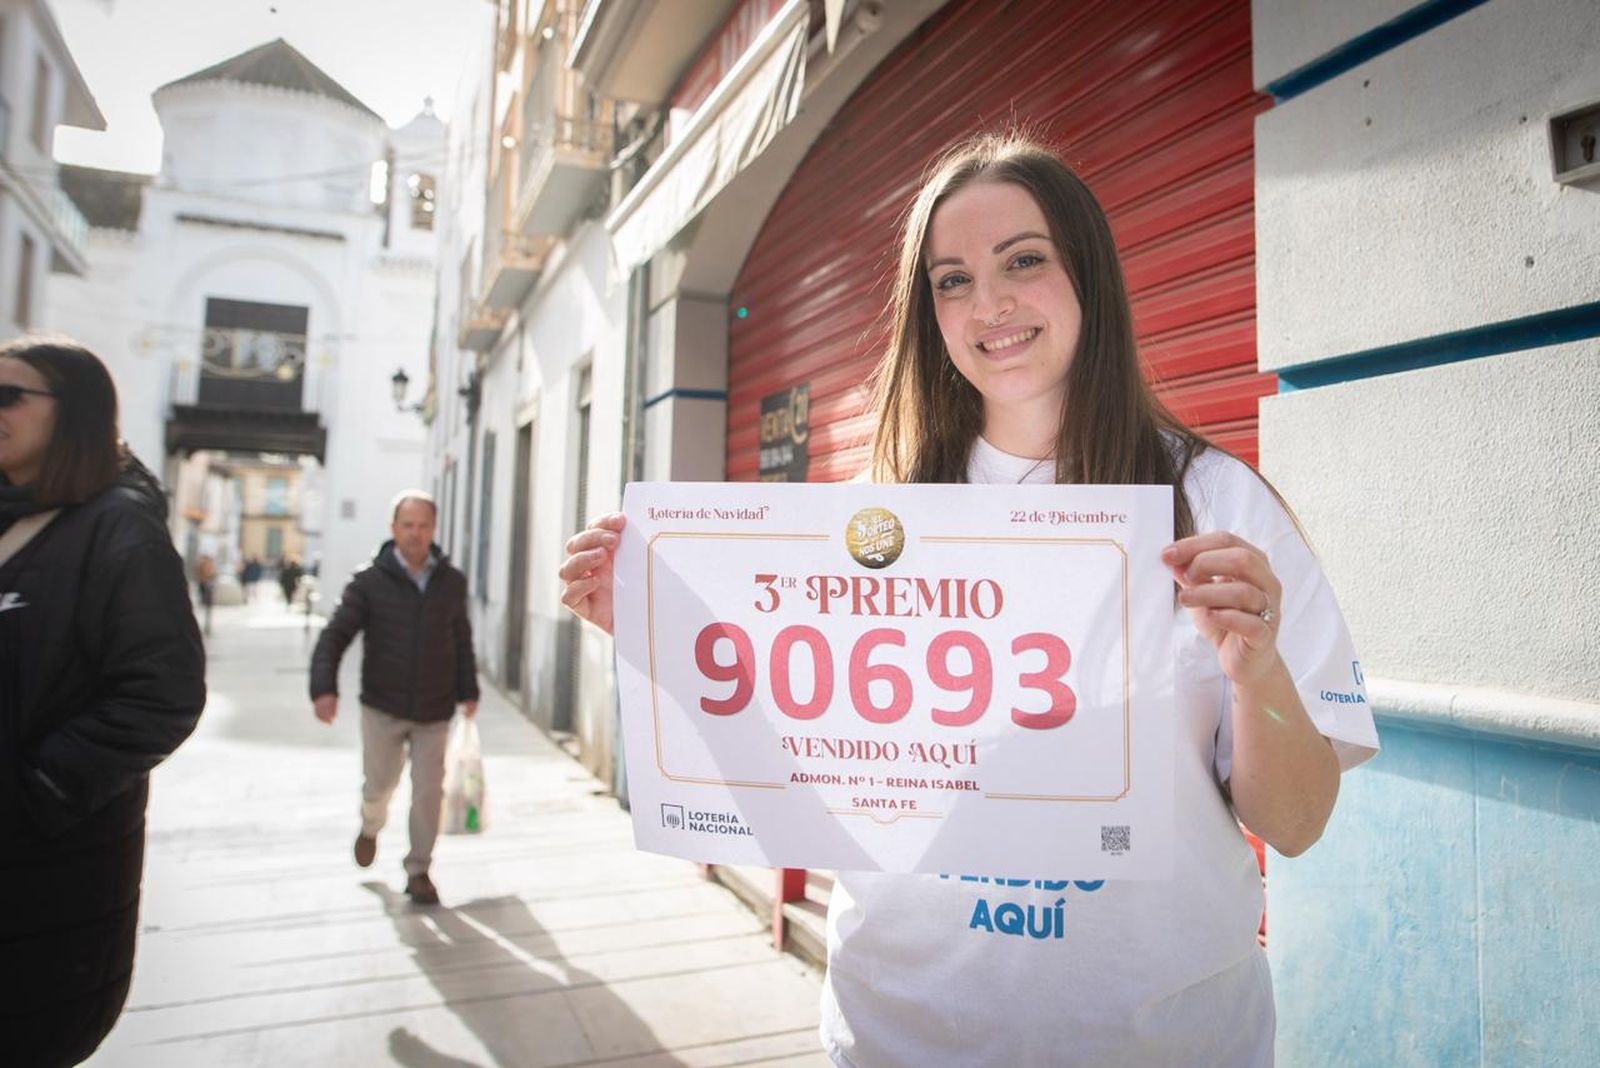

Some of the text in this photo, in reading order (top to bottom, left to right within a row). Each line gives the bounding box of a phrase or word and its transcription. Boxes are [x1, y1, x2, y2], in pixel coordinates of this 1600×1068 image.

[695, 507, 712, 520] de
[713, 505, 770, 520] Navidad
[1009, 510, 1127, 525] 22 de Diciembre
[805, 575, 1005, 620] PREMIO
[694, 621, 1078, 731] 90693
[781, 735, 978, 769] VENDIDO AQUÍ
[789, 772, 846, 786] ADMON.
[869, 777, 875, 787] 1
[885, 777, 929, 790] REINA
[931, 779, 981, 792] ISABEL
[851, 796, 918, 810] SANTA FE
[688, 810, 740, 825] LOTERÍA
[689, 822, 755, 837] NACIONAL
[968, 897, 1067, 940] AQUÍ
